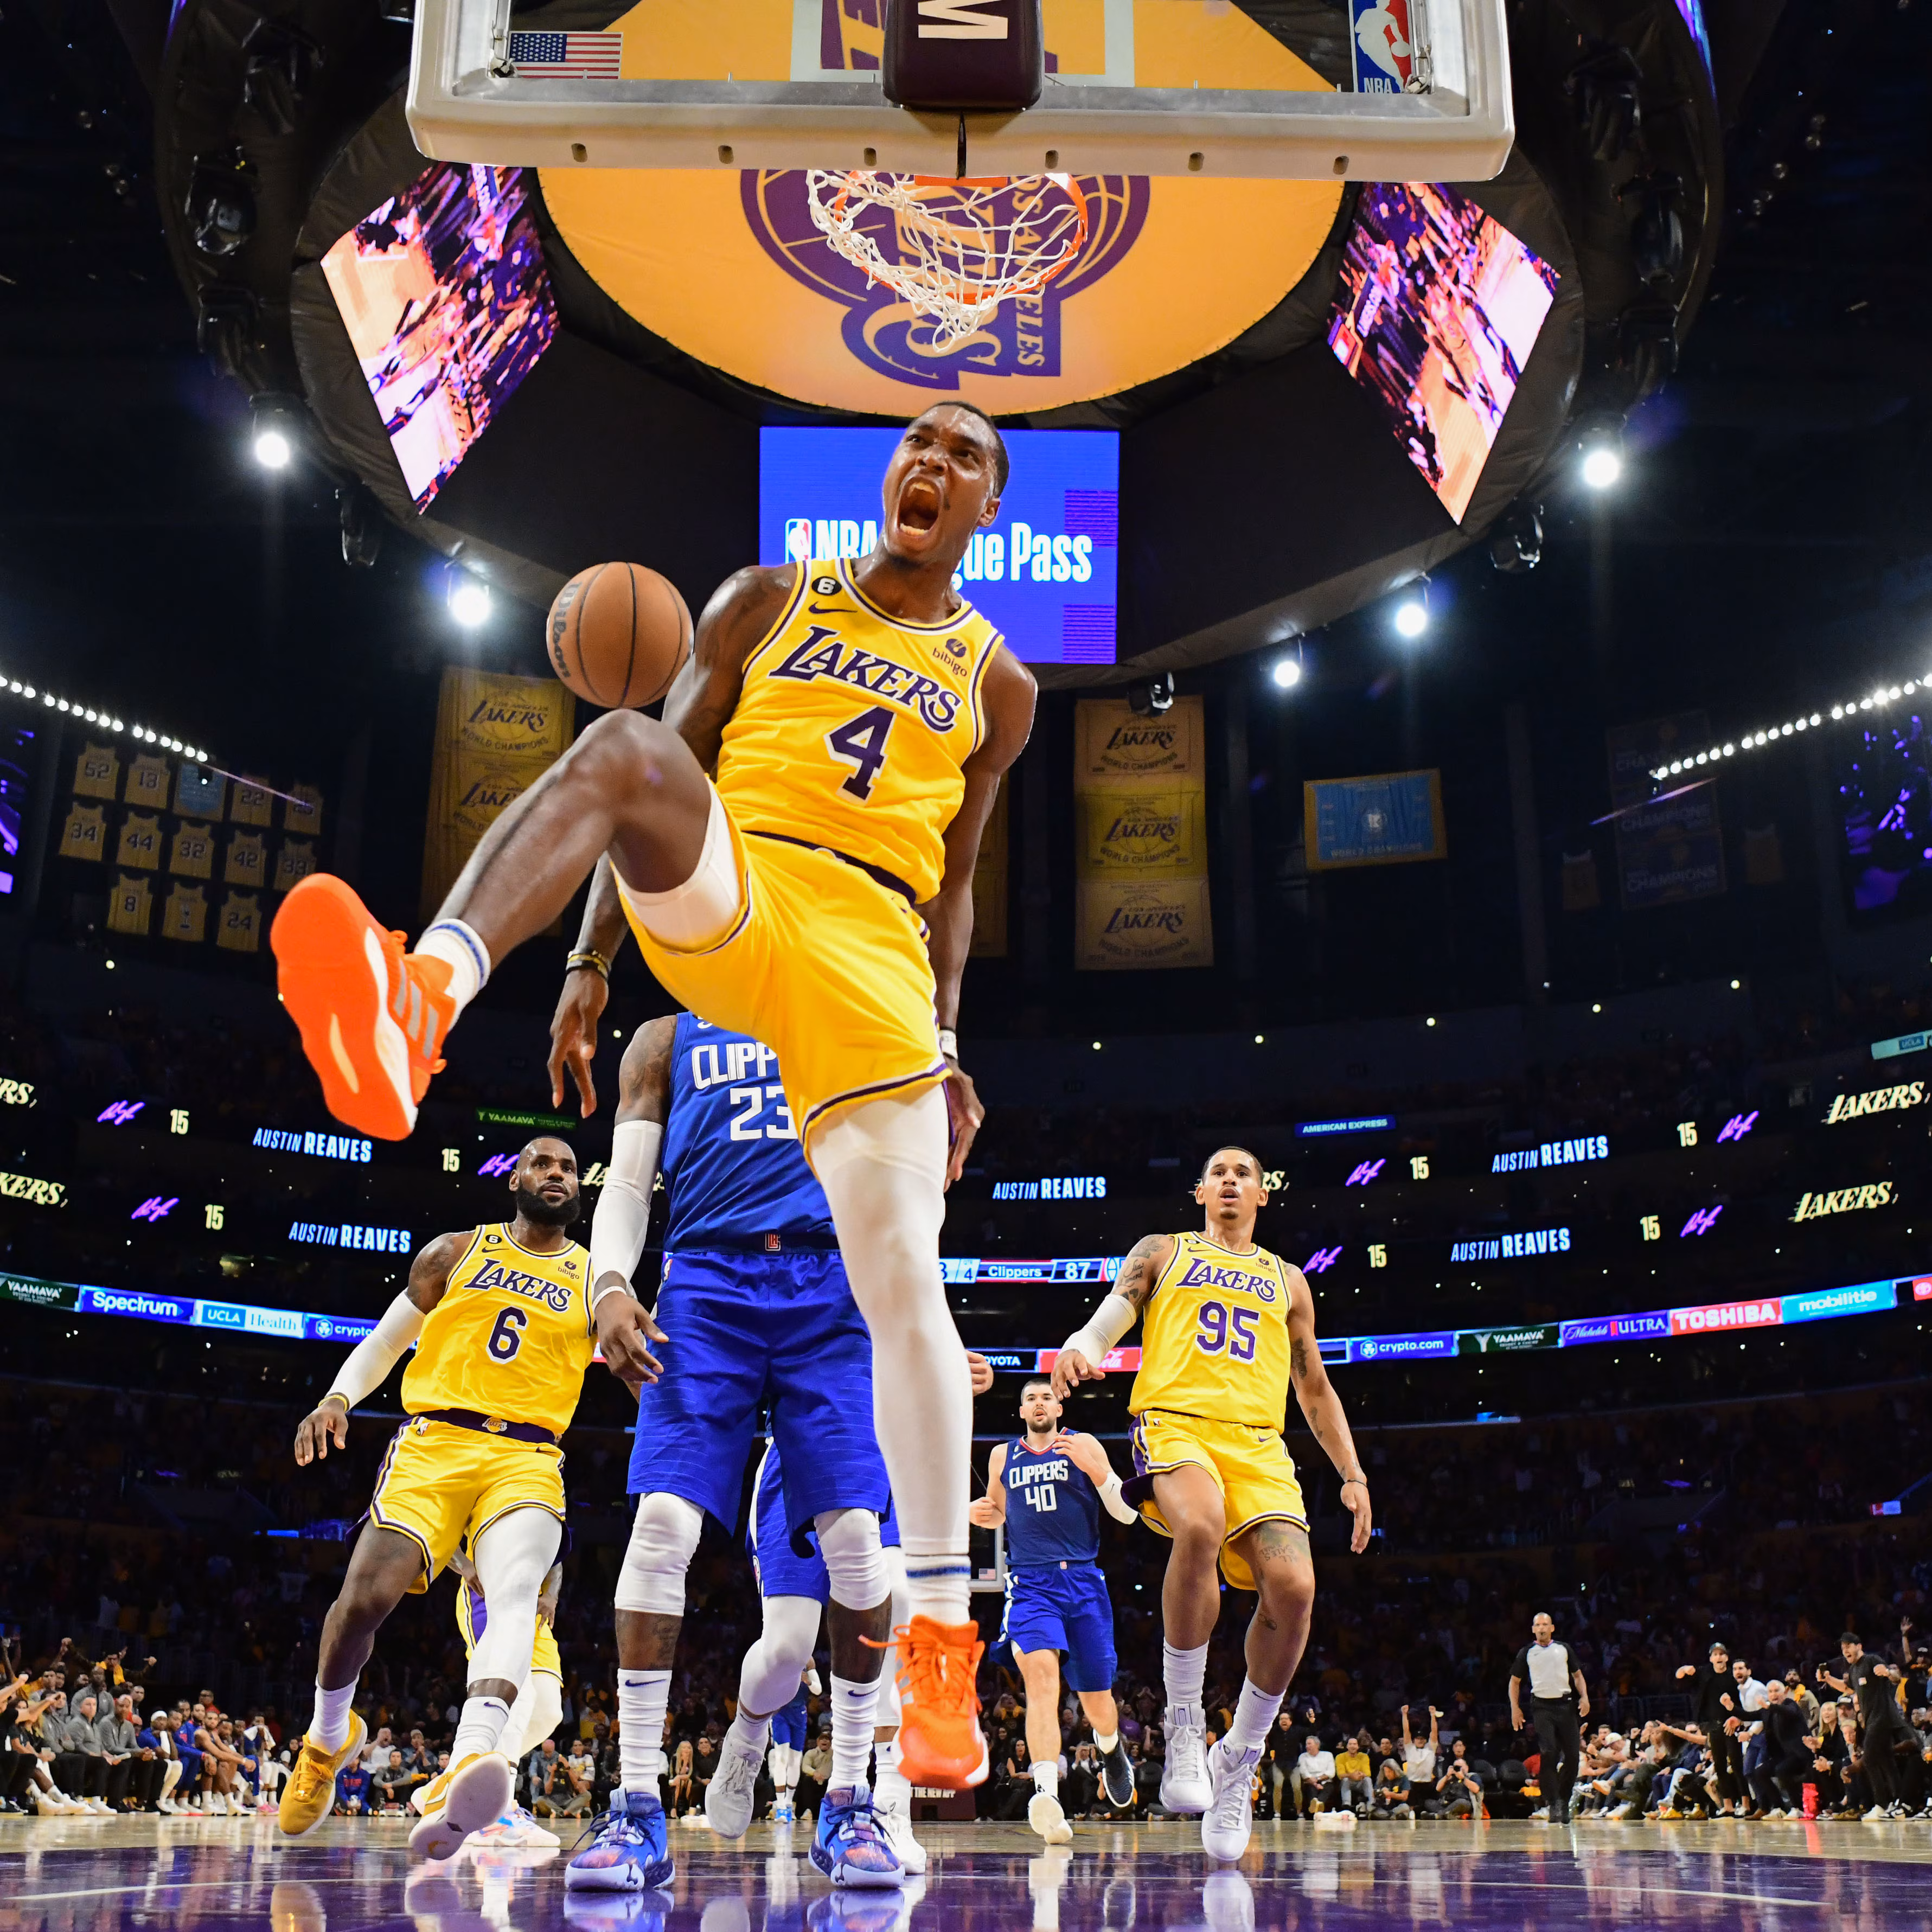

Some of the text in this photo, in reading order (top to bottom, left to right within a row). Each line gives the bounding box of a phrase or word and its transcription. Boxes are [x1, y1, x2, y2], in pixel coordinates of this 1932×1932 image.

[1364, 78, 1393, 93] NBA
[816, 519, 877, 559] NBA
[1010, 522, 1092, 583] Pass
[816, 578, 835, 594] 6
[931, 647, 968, 679] bibigo
[768, 625, 963, 734] LAKERS
[468, 699, 549, 733] LAKERS
[1106, 727, 1176, 750] LAKERS
[824, 705, 897, 805] 4
[71, 822, 98, 843] 34
[126, 833, 156, 852] 44
[1105, 817, 1179, 843] LAKERS
[227, 911, 253, 931] 24
[1104, 907, 1186, 934] LAKERS
[692, 1042, 779, 1089] CLIPP
[730, 1085, 799, 1141] 23
[1827, 1081, 1925, 1124] LAKERS
[169, 1109, 189, 1135] 15
[1302, 1118, 1389, 1134] AMERICAN EXPRESS
[1677, 1121, 1698, 1147] 15
[253, 1127, 373, 1162] AUSTIN REAVES
[1492, 1135, 1609, 1173] AUSTIN REAVES
[442, 1148, 460, 1172] 15
[1410, 1156, 1430, 1180] 15
[992, 1176, 1106, 1200] AUSTIN REAVES
[1794, 1181, 1892, 1223] LAKERS
[204, 1204, 225, 1230] 15
[1640, 1215, 1660, 1241] 15
[289, 1221, 412, 1253] AUSTIN REAVES
[488, 1235, 498, 1244] 6
[1450, 1227, 1571, 1263] AUSTIN REAVES
[1255, 1262, 1276, 1273] bibigo
[1367, 1243, 1387, 1268] 15
[558, 1265, 580, 1281] bibigo
[963, 1268, 974, 1281] 4
[988, 1262, 1091, 1280] Clippers 87
[1176, 1258, 1276, 1303] LAKERS
[464, 1258, 572, 1313] LAKERS
[92, 1291, 178, 1317] Spectrum
[1799, 1289, 1877, 1312] mobilitie
[207, 1309, 297, 1330] UCLA Health
[1617, 1317, 1666, 1334] ULTRA
[1675, 1303, 1776, 1330] TOSHIBA
[334, 1324, 373, 1338] crypto
[486, 1305, 529, 1364] 6
[1195, 1301, 1261, 1365] 95
[1379, 1337, 1444, 1353] crypto.com
[984, 1355, 1021, 1366] OYOTA
[484, 1418, 506, 1430] LAKERS
[1009, 1459, 1068, 1489] CLIPPERS
[1025, 1483, 1057, 1512] 40
